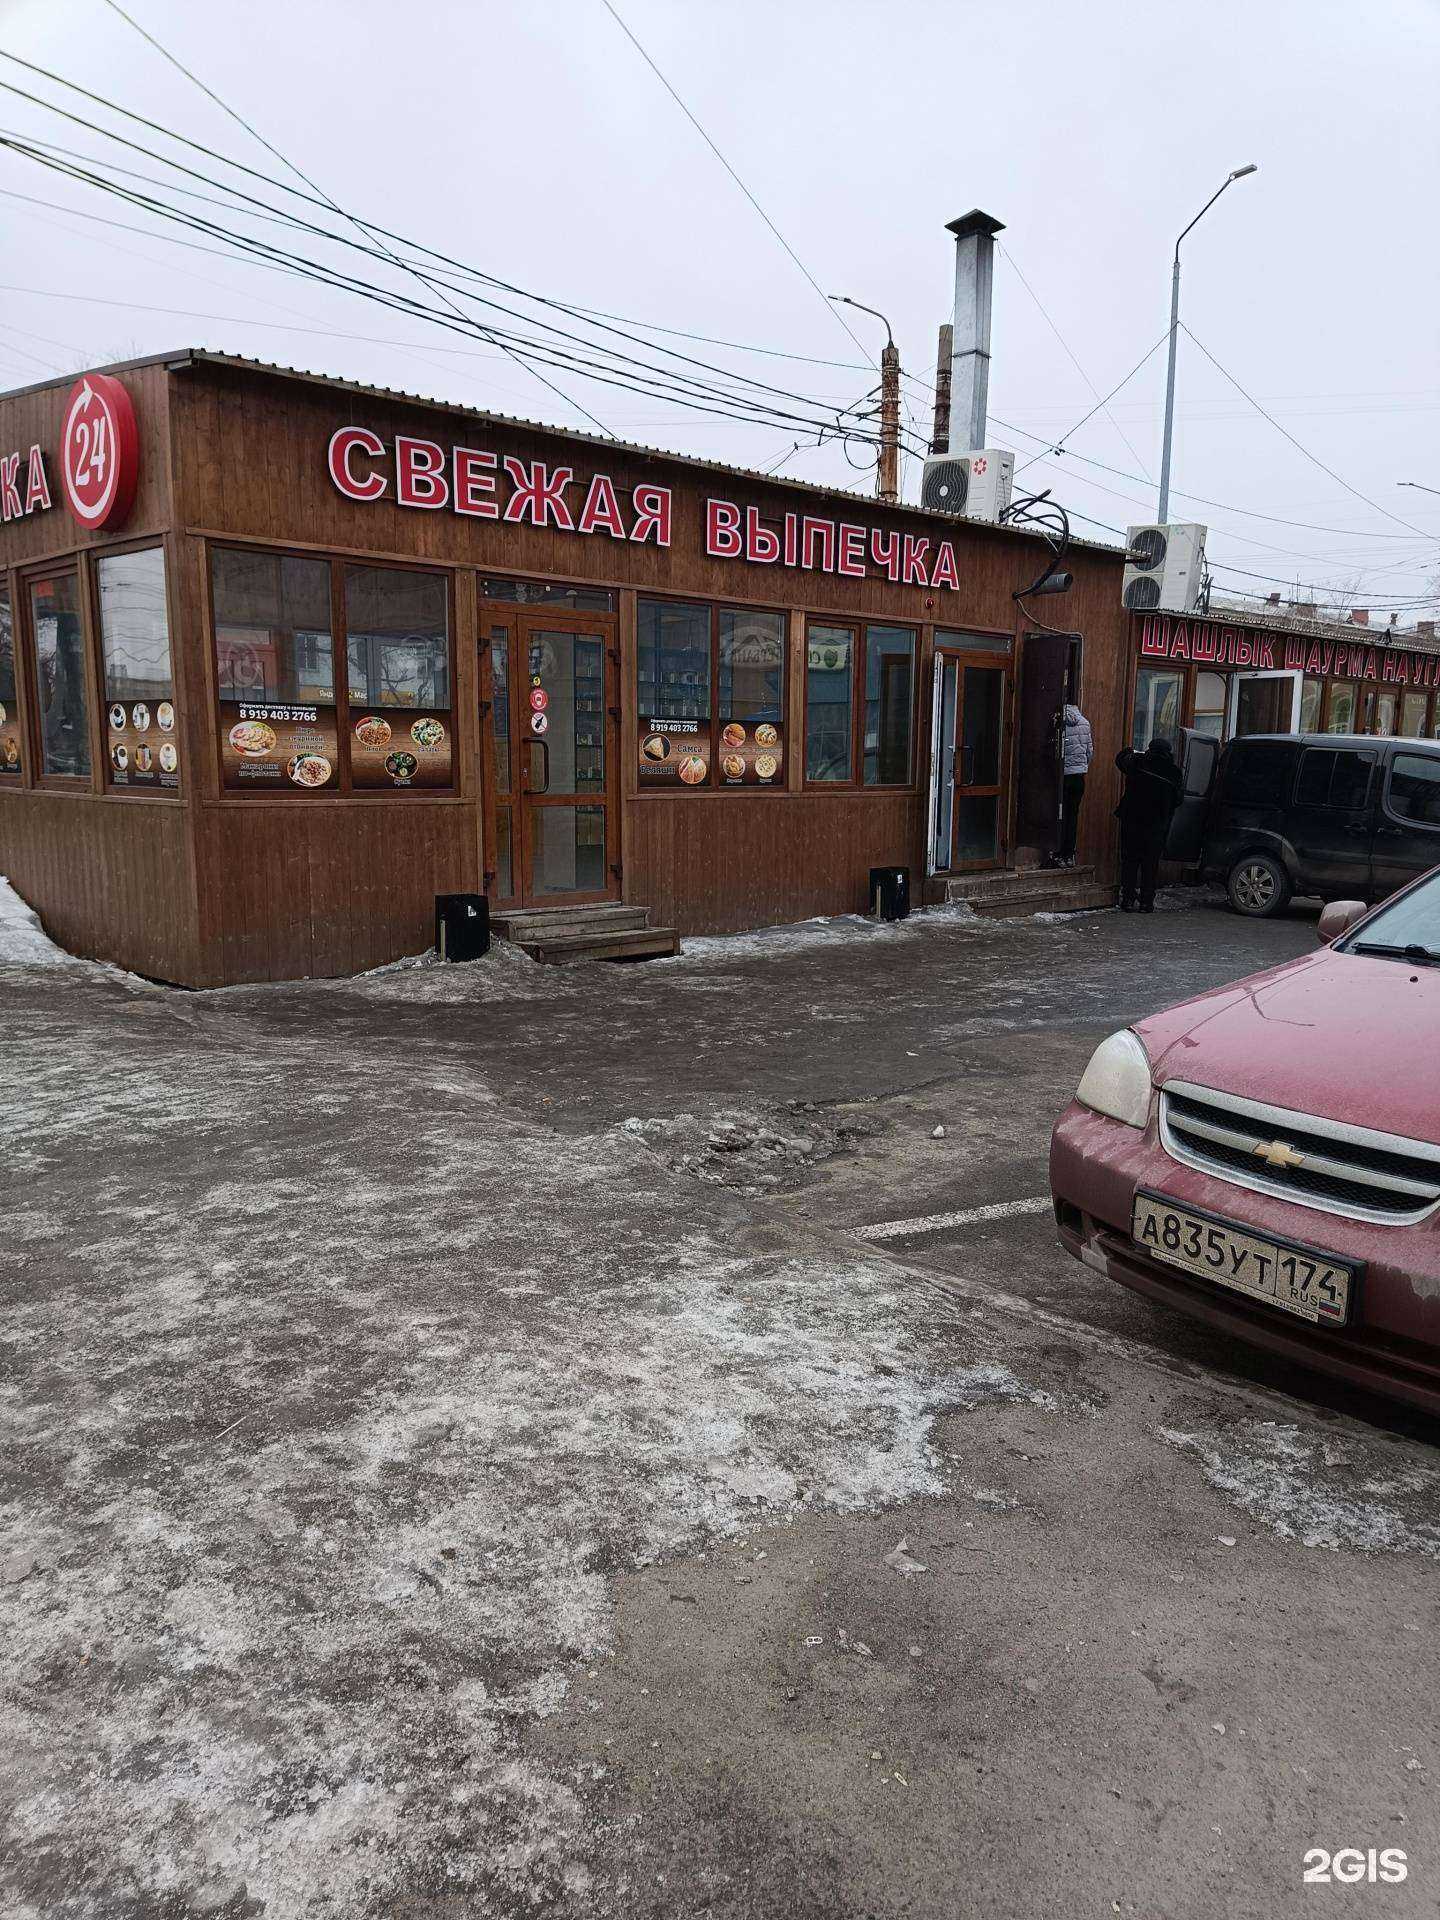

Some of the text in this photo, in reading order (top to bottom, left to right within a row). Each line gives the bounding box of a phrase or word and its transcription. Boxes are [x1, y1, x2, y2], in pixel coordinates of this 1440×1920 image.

[76, 416, 107, 487] 24
[328, 426, 960, 591] СВЕЖАЯ ВЫПЕЧКА
[1142, 615, 1278, 669] ШАШЛЫК
[1285, 636, 1377, 679] ШАУРМА
[1382, 650, 1409, 684] НА
[239, 709, 317, 721] 8 919 403 2766
[650, 723, 655, 731] 8
[656, 724, 669, 732] 919
[669, 724, 682, 732] 403
[677, 743, 703, 753] Самса
[1142, 1212, 1273, 1285] А835УТ
[1281, 1255, 1338, 1302] 174
[1290, 1286, 1319, 1308] RUS
